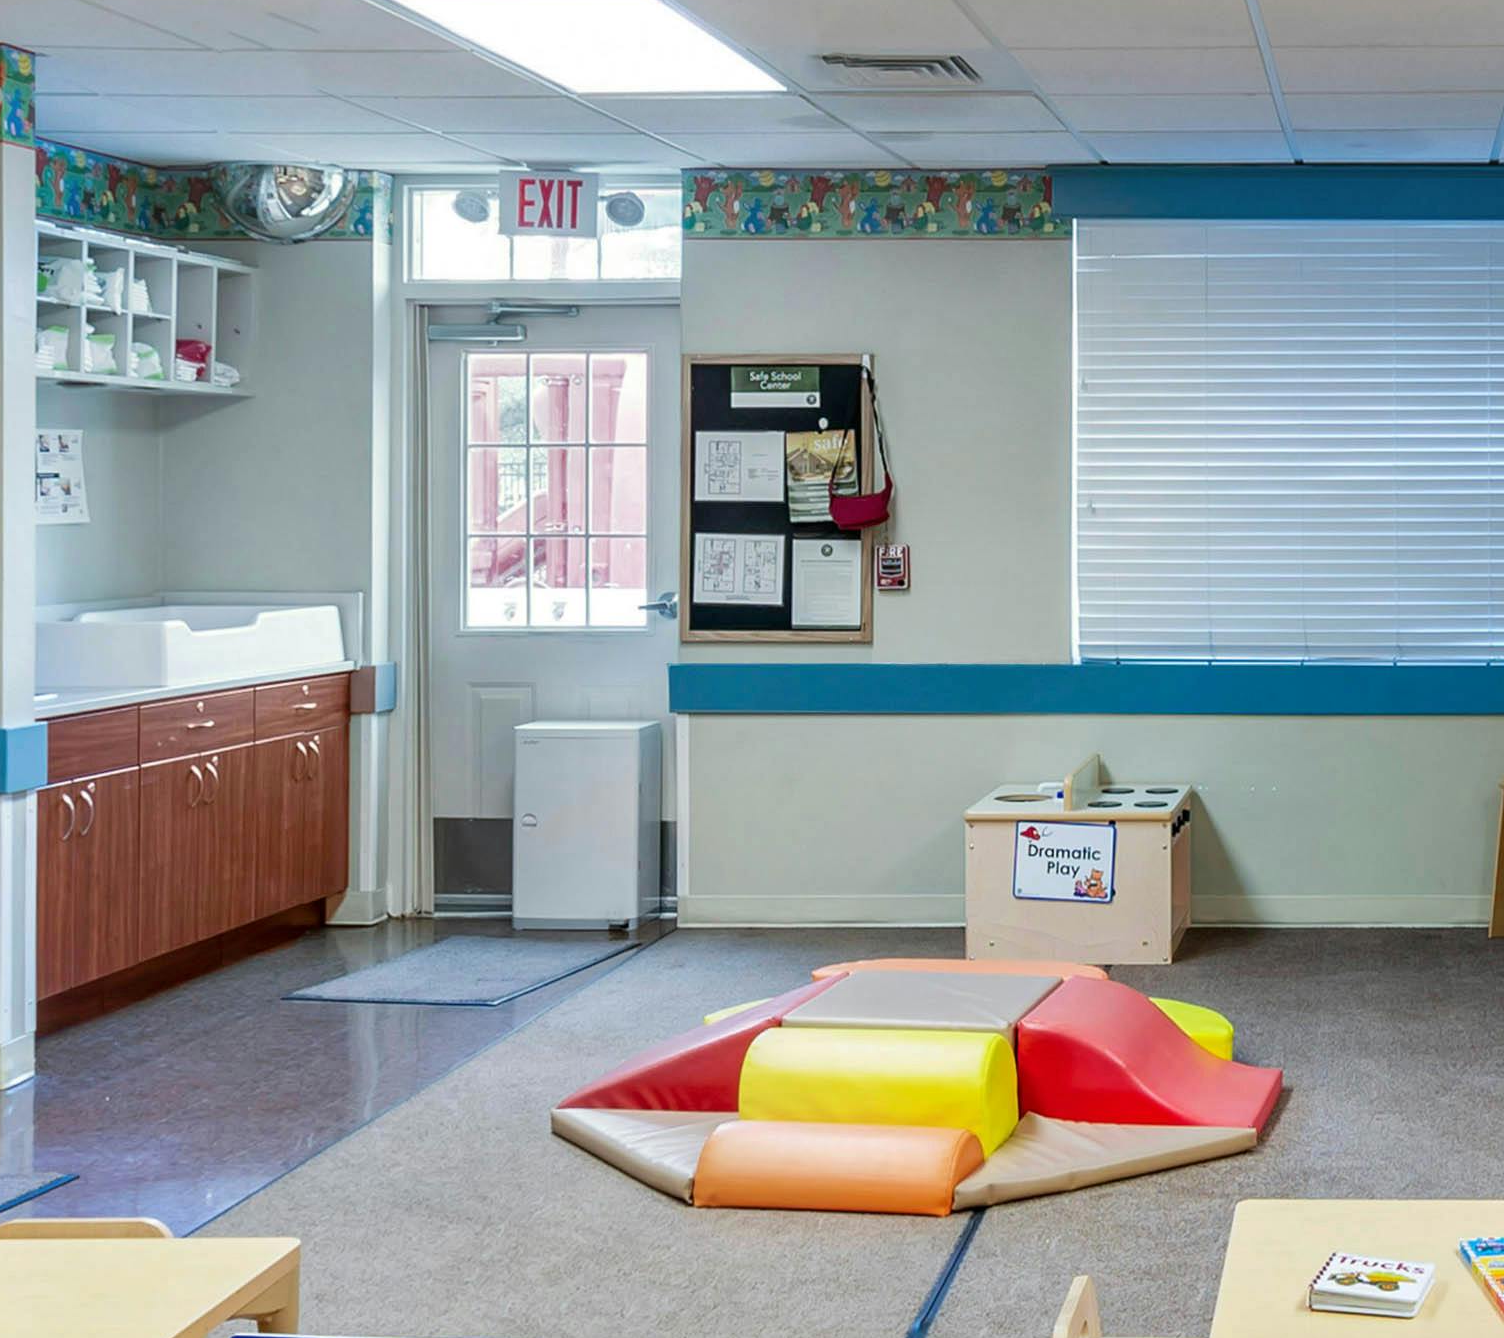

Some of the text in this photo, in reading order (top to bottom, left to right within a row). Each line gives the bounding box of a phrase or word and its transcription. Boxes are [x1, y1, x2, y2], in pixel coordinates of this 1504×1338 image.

[517, 178, 583, 229] EXIT
[749, 371, 801, 382] Safe School
[760, 380, 792, 390] Center
[879, 547, 903, 557] FIRE
[1028, 844, 1101, 861] Dramatic
[1047, 861, 1080, 878] Play
[1340, 1256, 1425, 1274] Trucks
